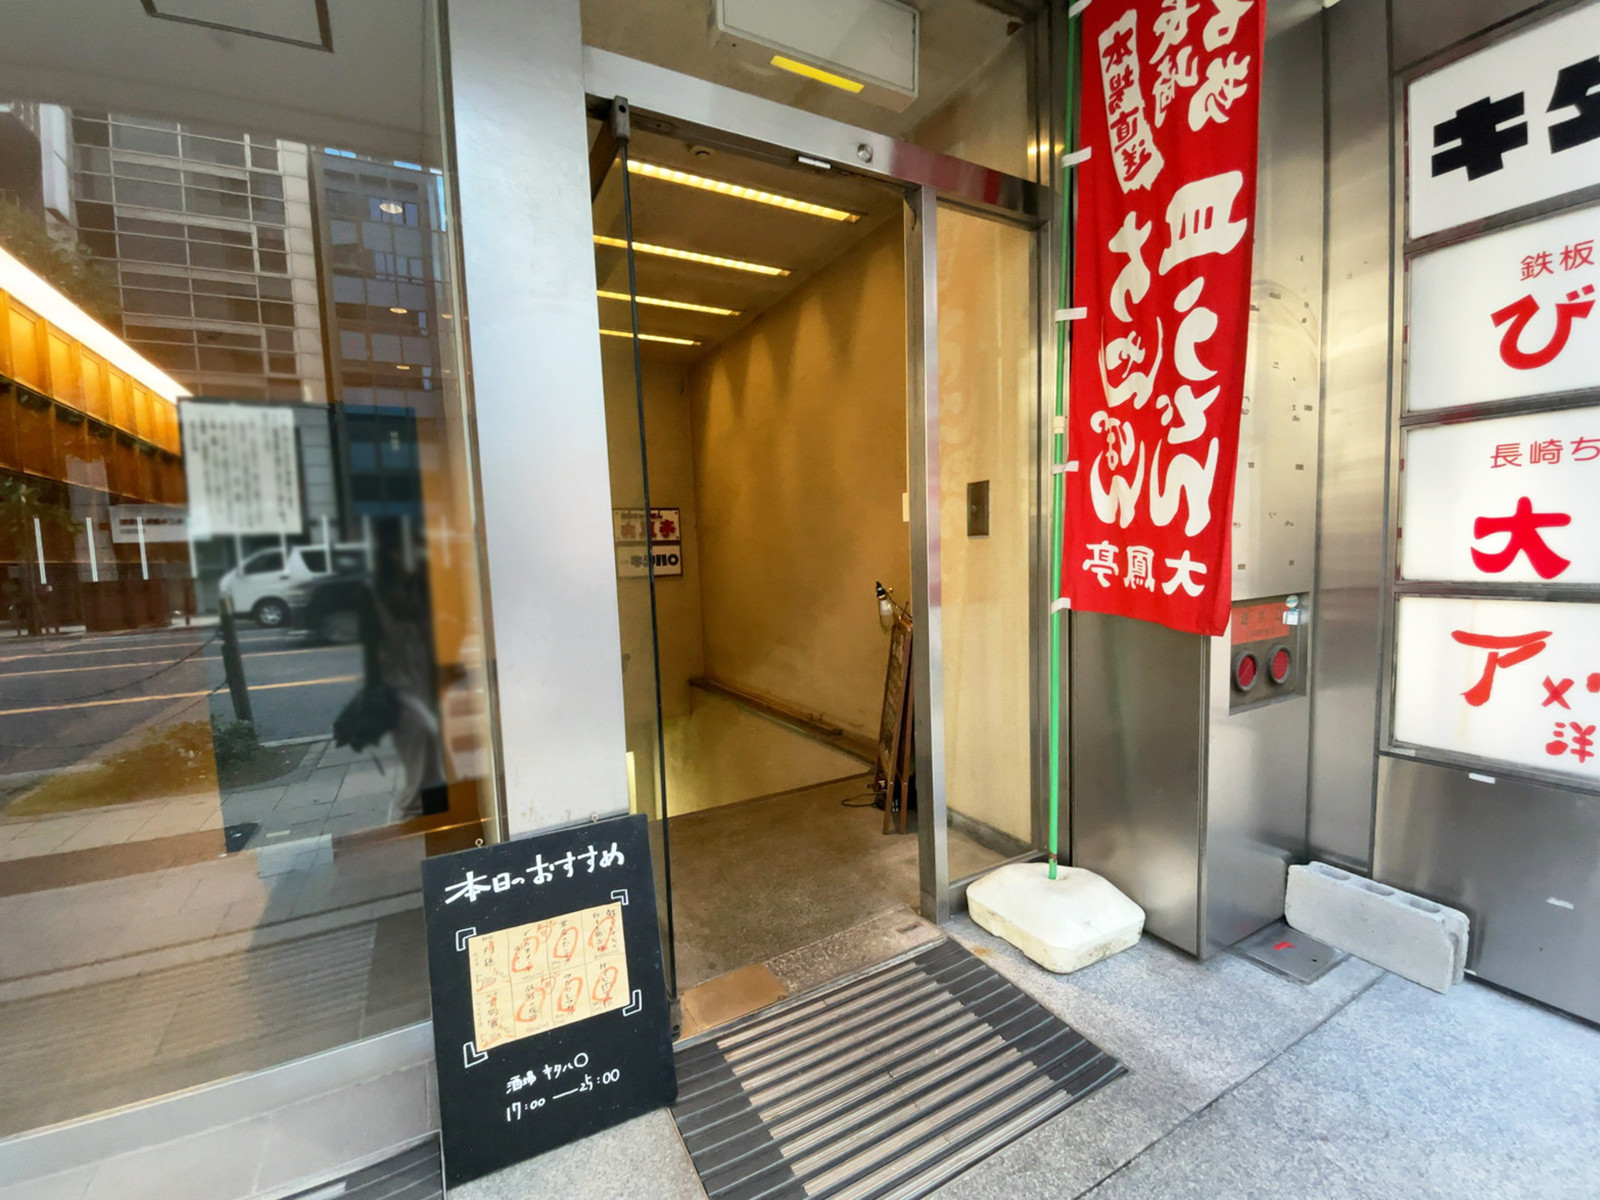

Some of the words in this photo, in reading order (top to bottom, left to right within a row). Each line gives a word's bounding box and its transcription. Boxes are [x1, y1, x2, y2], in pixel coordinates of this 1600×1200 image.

[1520, 240, 1595, 281] 鉄板
[1490, 283, 1596, 370] び
[1490, 436, 1600, 469] 長崎ち
[1470, 496, 1572, 580] 大
[1545, 722, 1596, 763] 洋
[444, 842, 625, 905] 本日のおすすめ
[506, 1069, 537, 1095] 酒場
